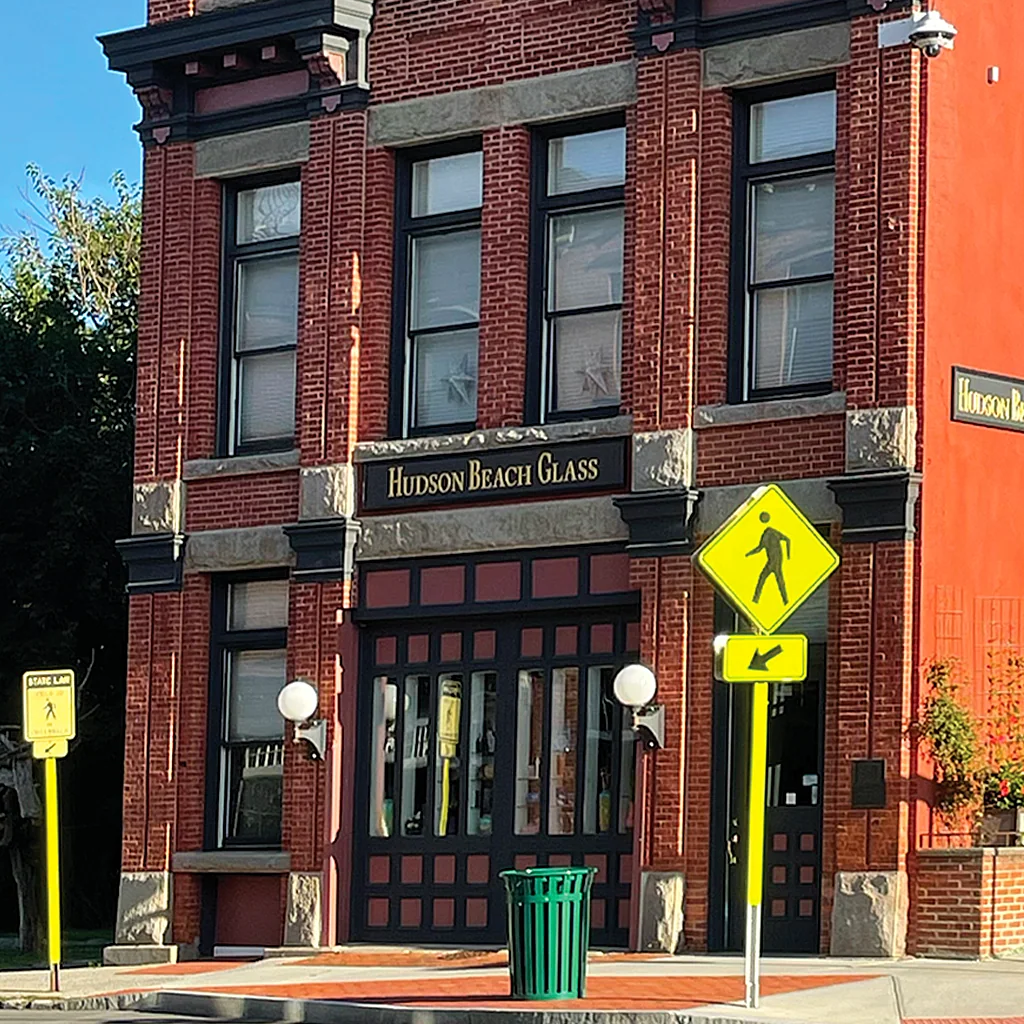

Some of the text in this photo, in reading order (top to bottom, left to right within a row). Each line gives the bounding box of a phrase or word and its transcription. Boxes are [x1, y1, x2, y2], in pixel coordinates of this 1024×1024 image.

[387, 451, 599, 498] HUDSON BEACH GLASS
